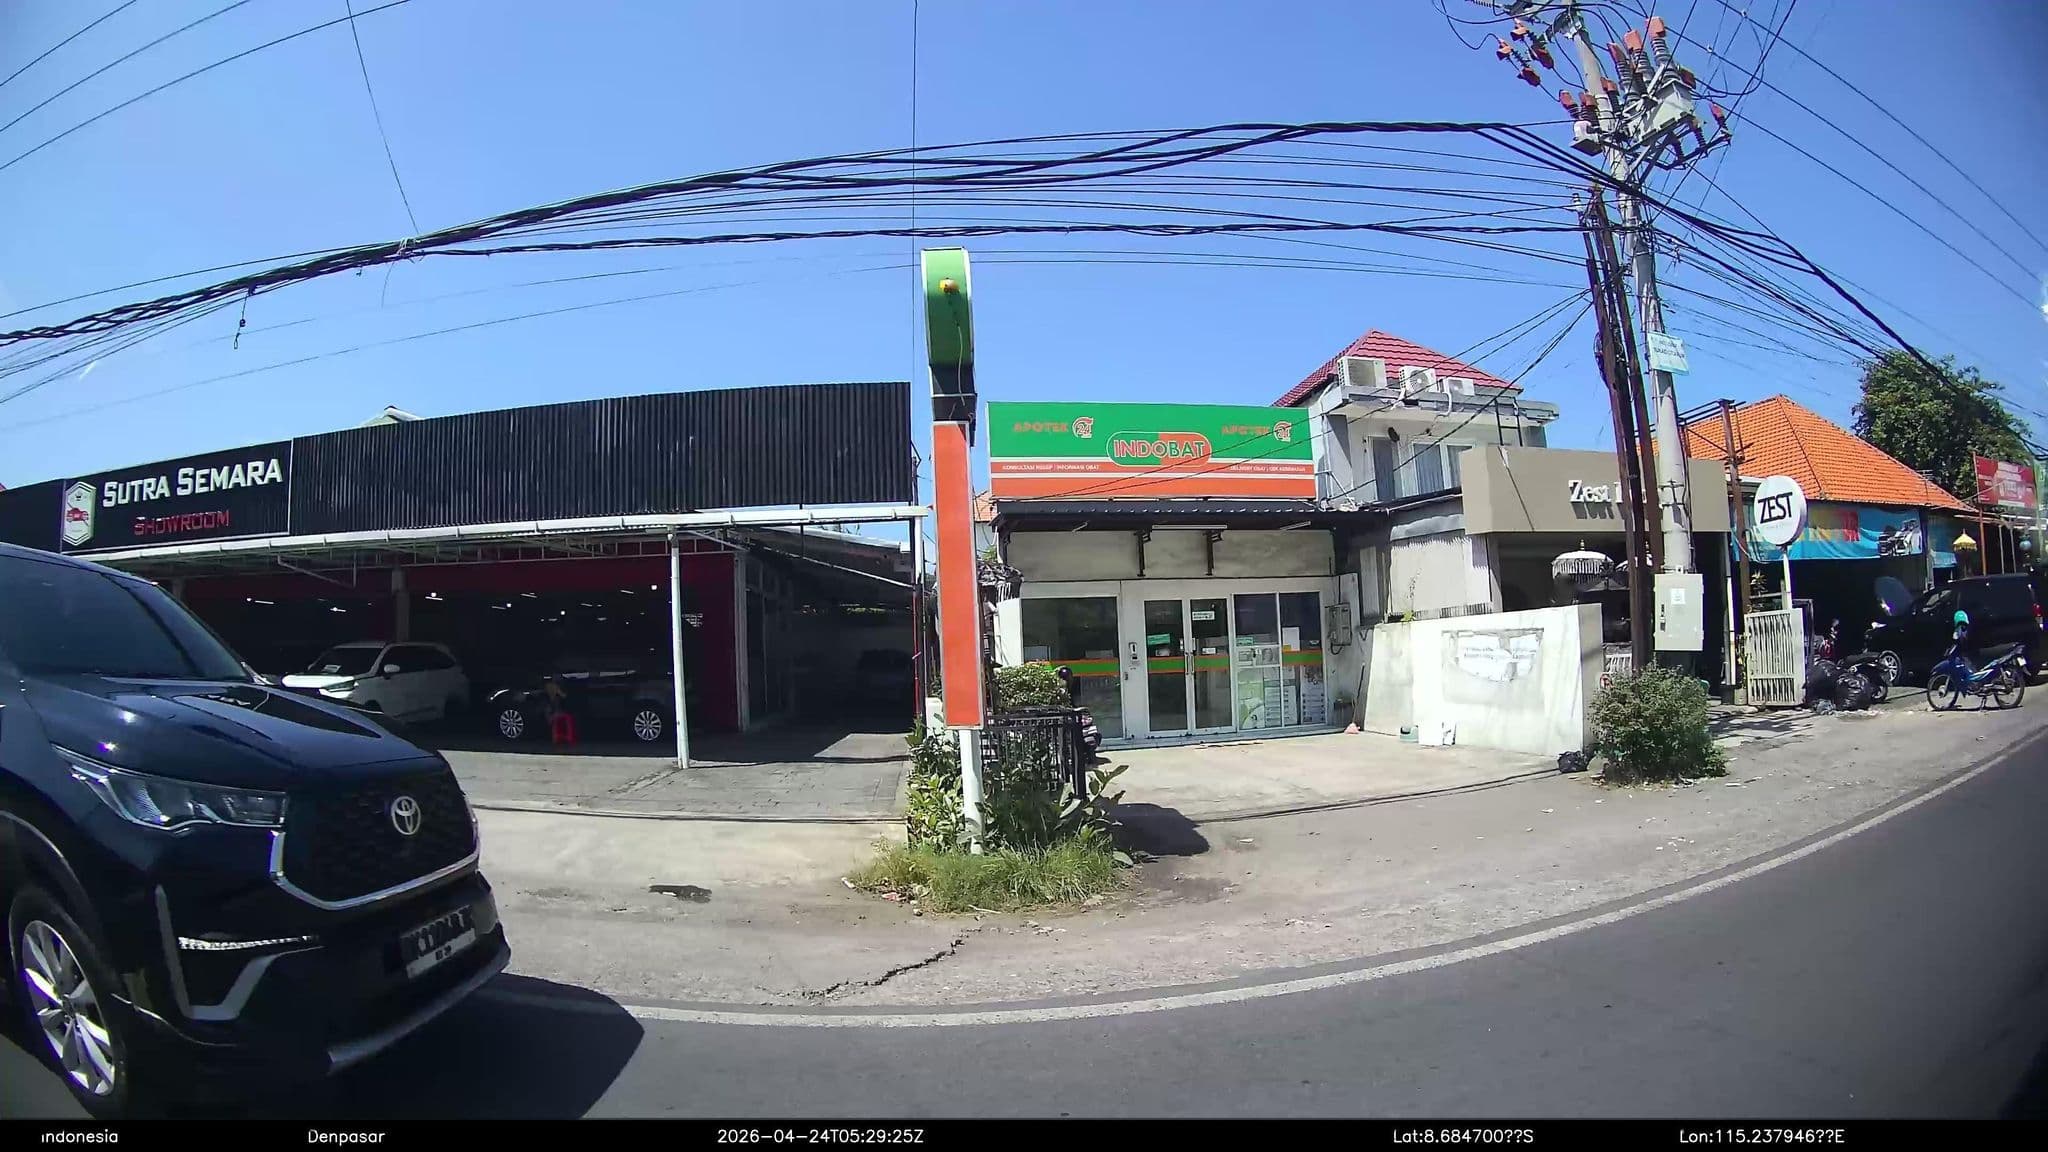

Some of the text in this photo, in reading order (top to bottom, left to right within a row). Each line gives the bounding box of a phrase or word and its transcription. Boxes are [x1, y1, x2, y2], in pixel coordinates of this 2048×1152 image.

[1113, 439, 1206, 459] INDOBAT
[102, 458, 283, 508] SUTRA SEMARA
[1568, 479, 1611, 502] Zest
[1757, 491, 1793, 524] ZEST
[133, 509, 230, 536] SHOWROOM
